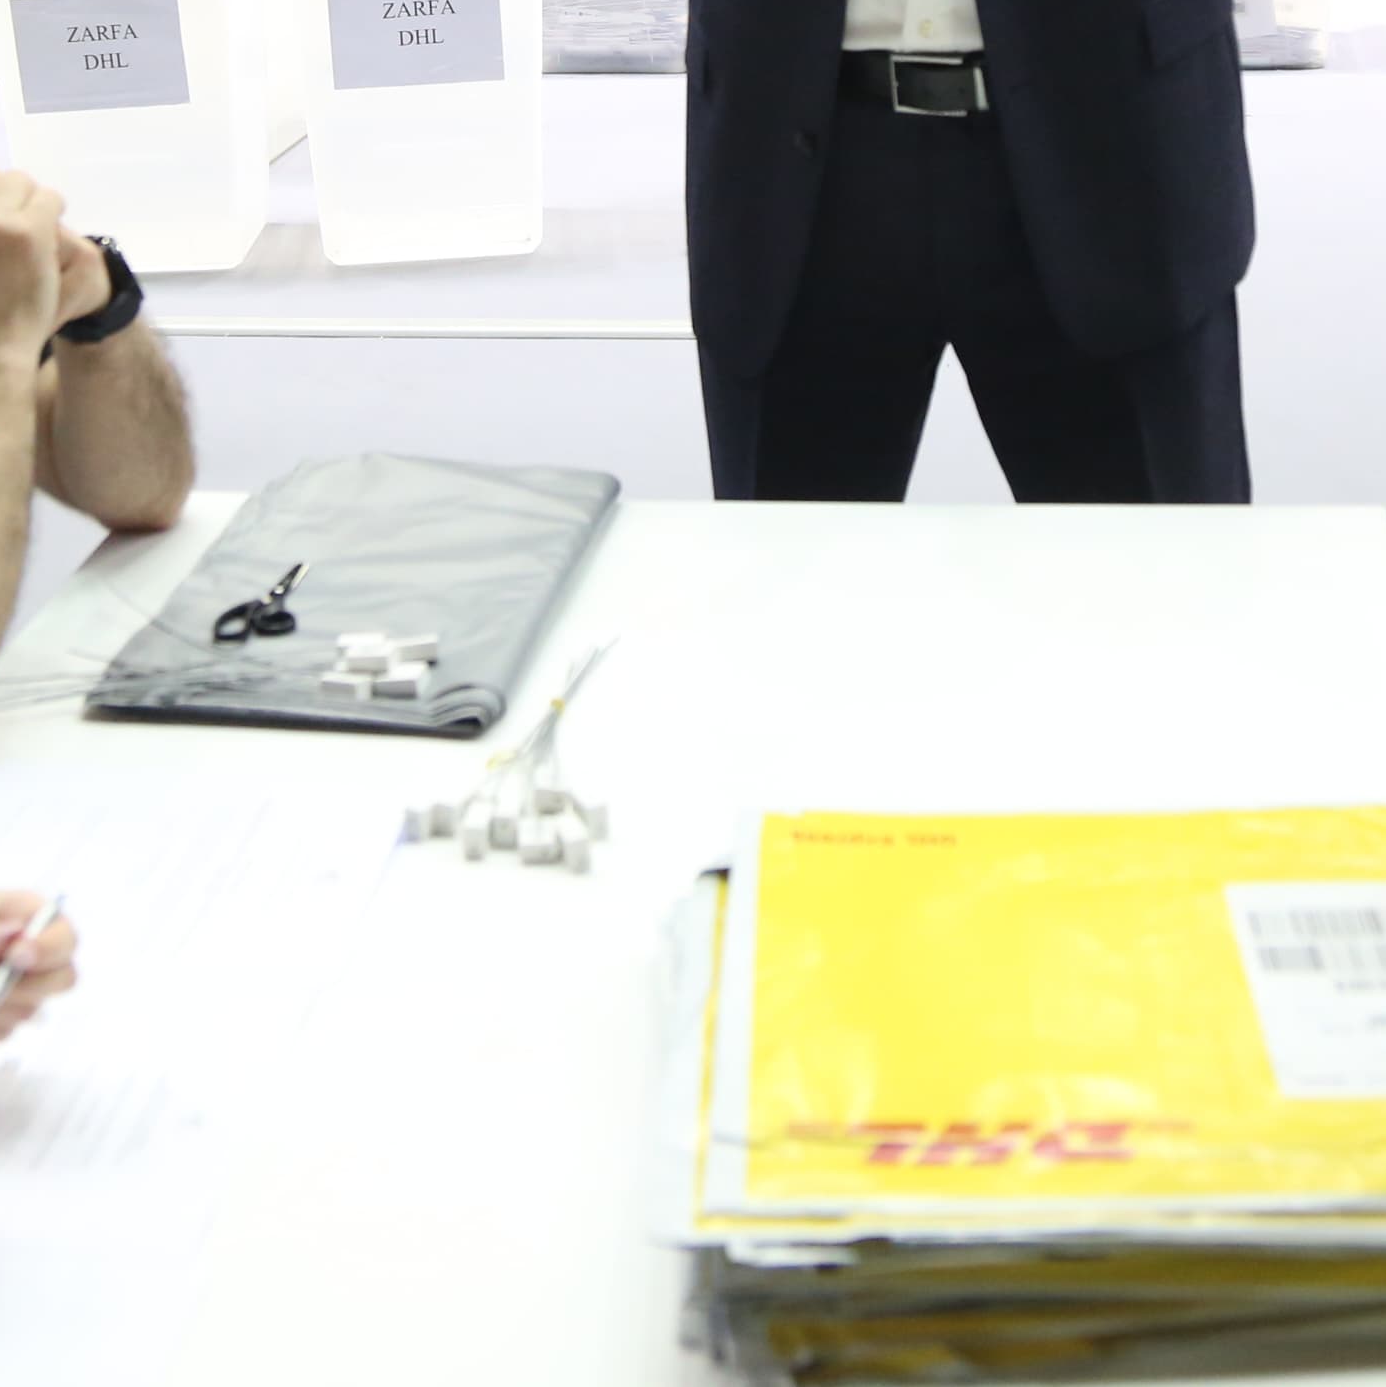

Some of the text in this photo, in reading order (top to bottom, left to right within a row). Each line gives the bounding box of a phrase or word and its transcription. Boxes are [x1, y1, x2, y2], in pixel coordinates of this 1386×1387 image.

[66, 23, 139, 44] ZARFA
[398, 28, 445, 47] DHL
[83, 52, 129, 71] DHL
